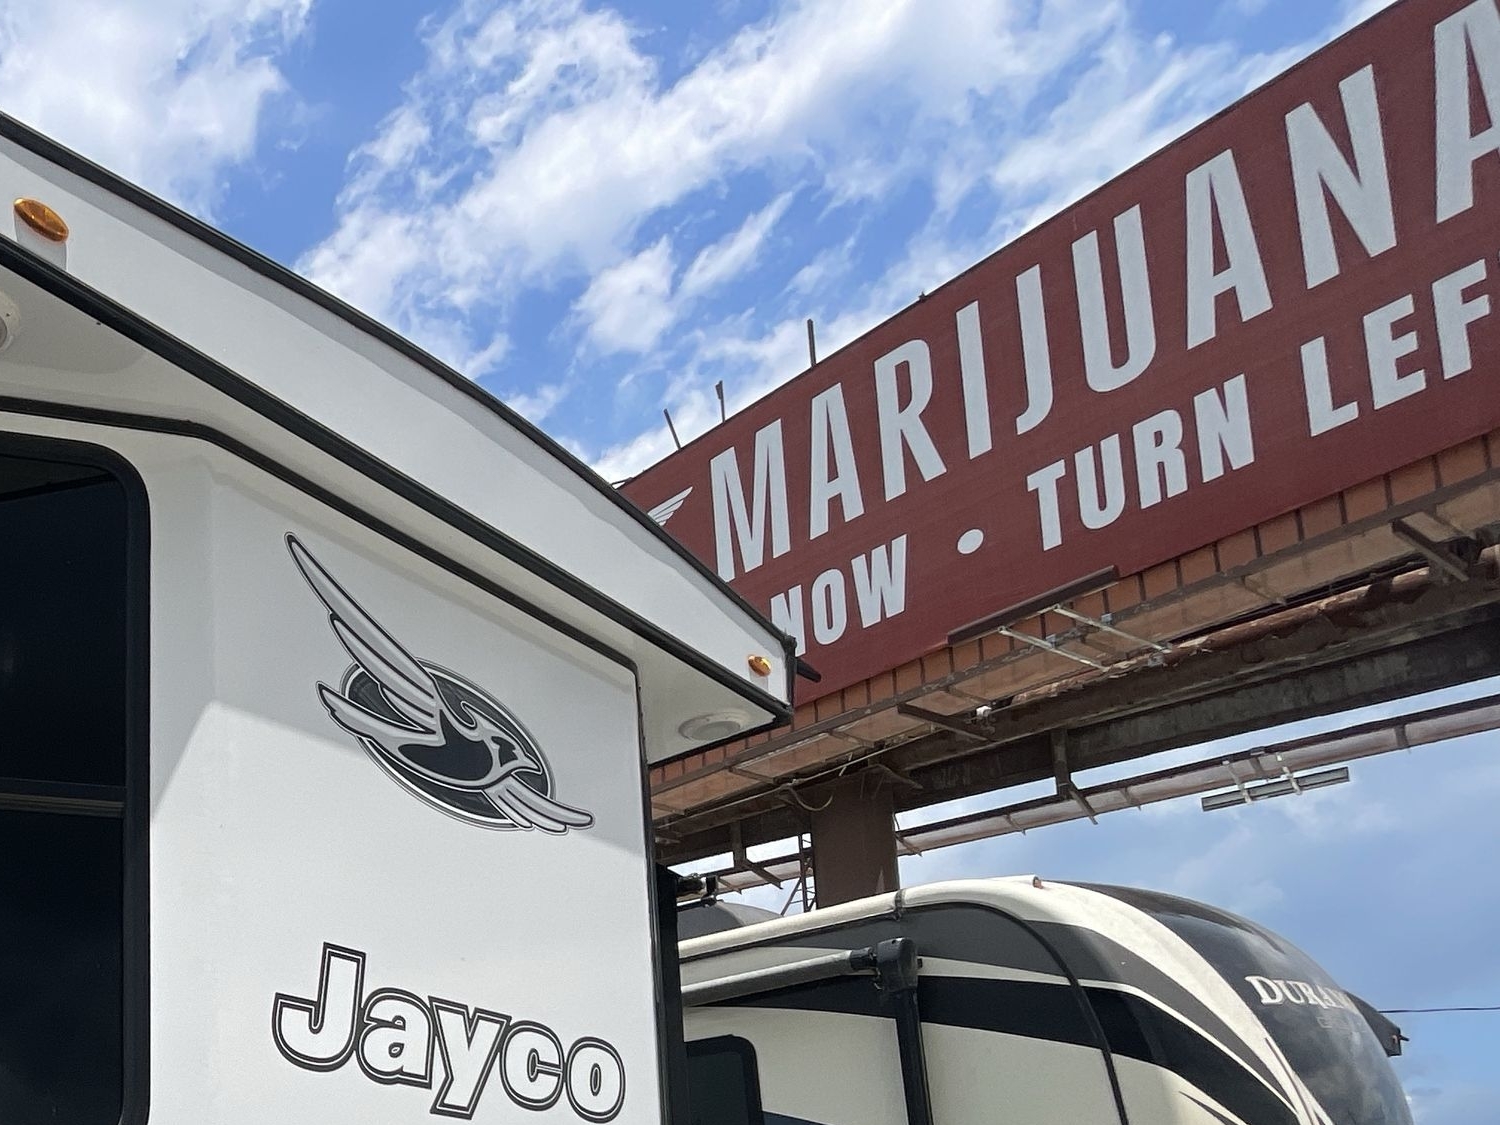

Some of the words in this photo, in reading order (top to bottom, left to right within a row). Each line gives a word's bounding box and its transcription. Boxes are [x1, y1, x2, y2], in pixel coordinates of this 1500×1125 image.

[709, 0, 1500, 584] MARIJUANA
[770, 533, 908, 658] NOW
[1026, 373, 1255, 552] TURN
[1301, 255, 1500, 438] LEF
[271, 941, 626, 1124] Jayco
